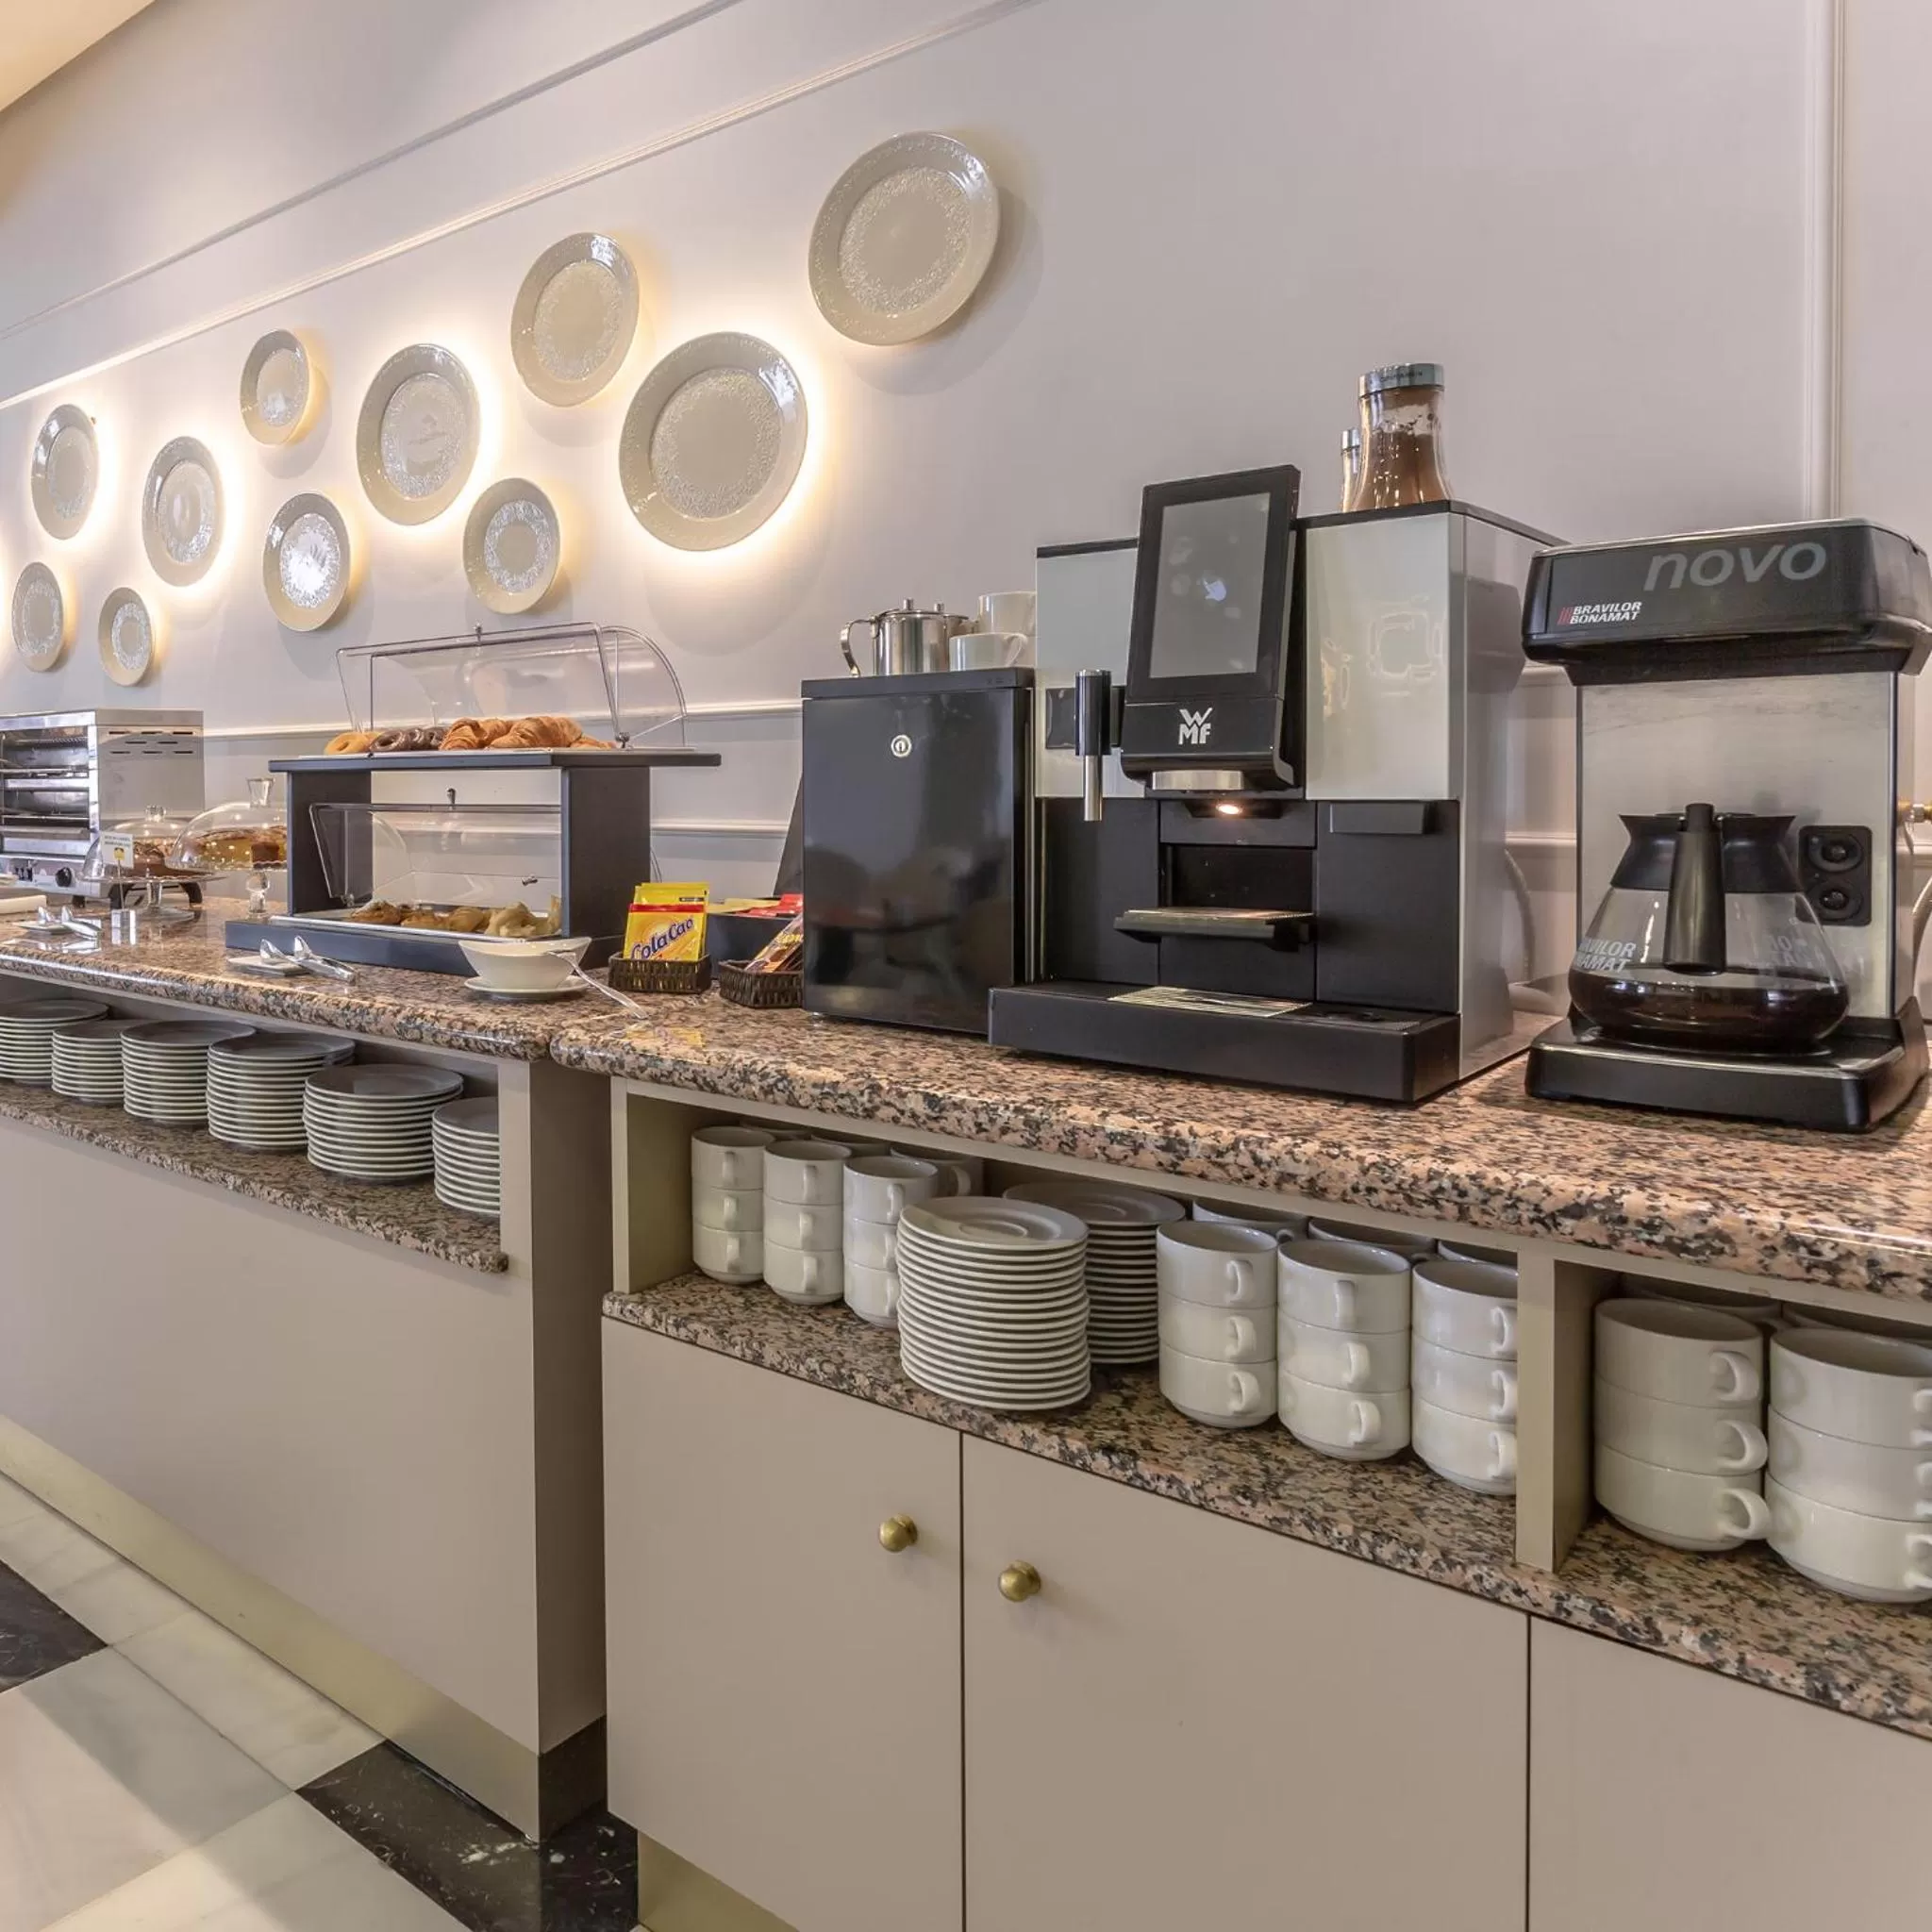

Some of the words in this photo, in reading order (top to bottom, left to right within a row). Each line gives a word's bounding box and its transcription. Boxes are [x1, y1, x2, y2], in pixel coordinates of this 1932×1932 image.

[1643, 542, 1826, 591] novo
[1570, 611, 1640, 624] BONAMAT
[1573, 601, 1642, 615] BRAVILOR
[1178, 707, 1213, 745] WMF
